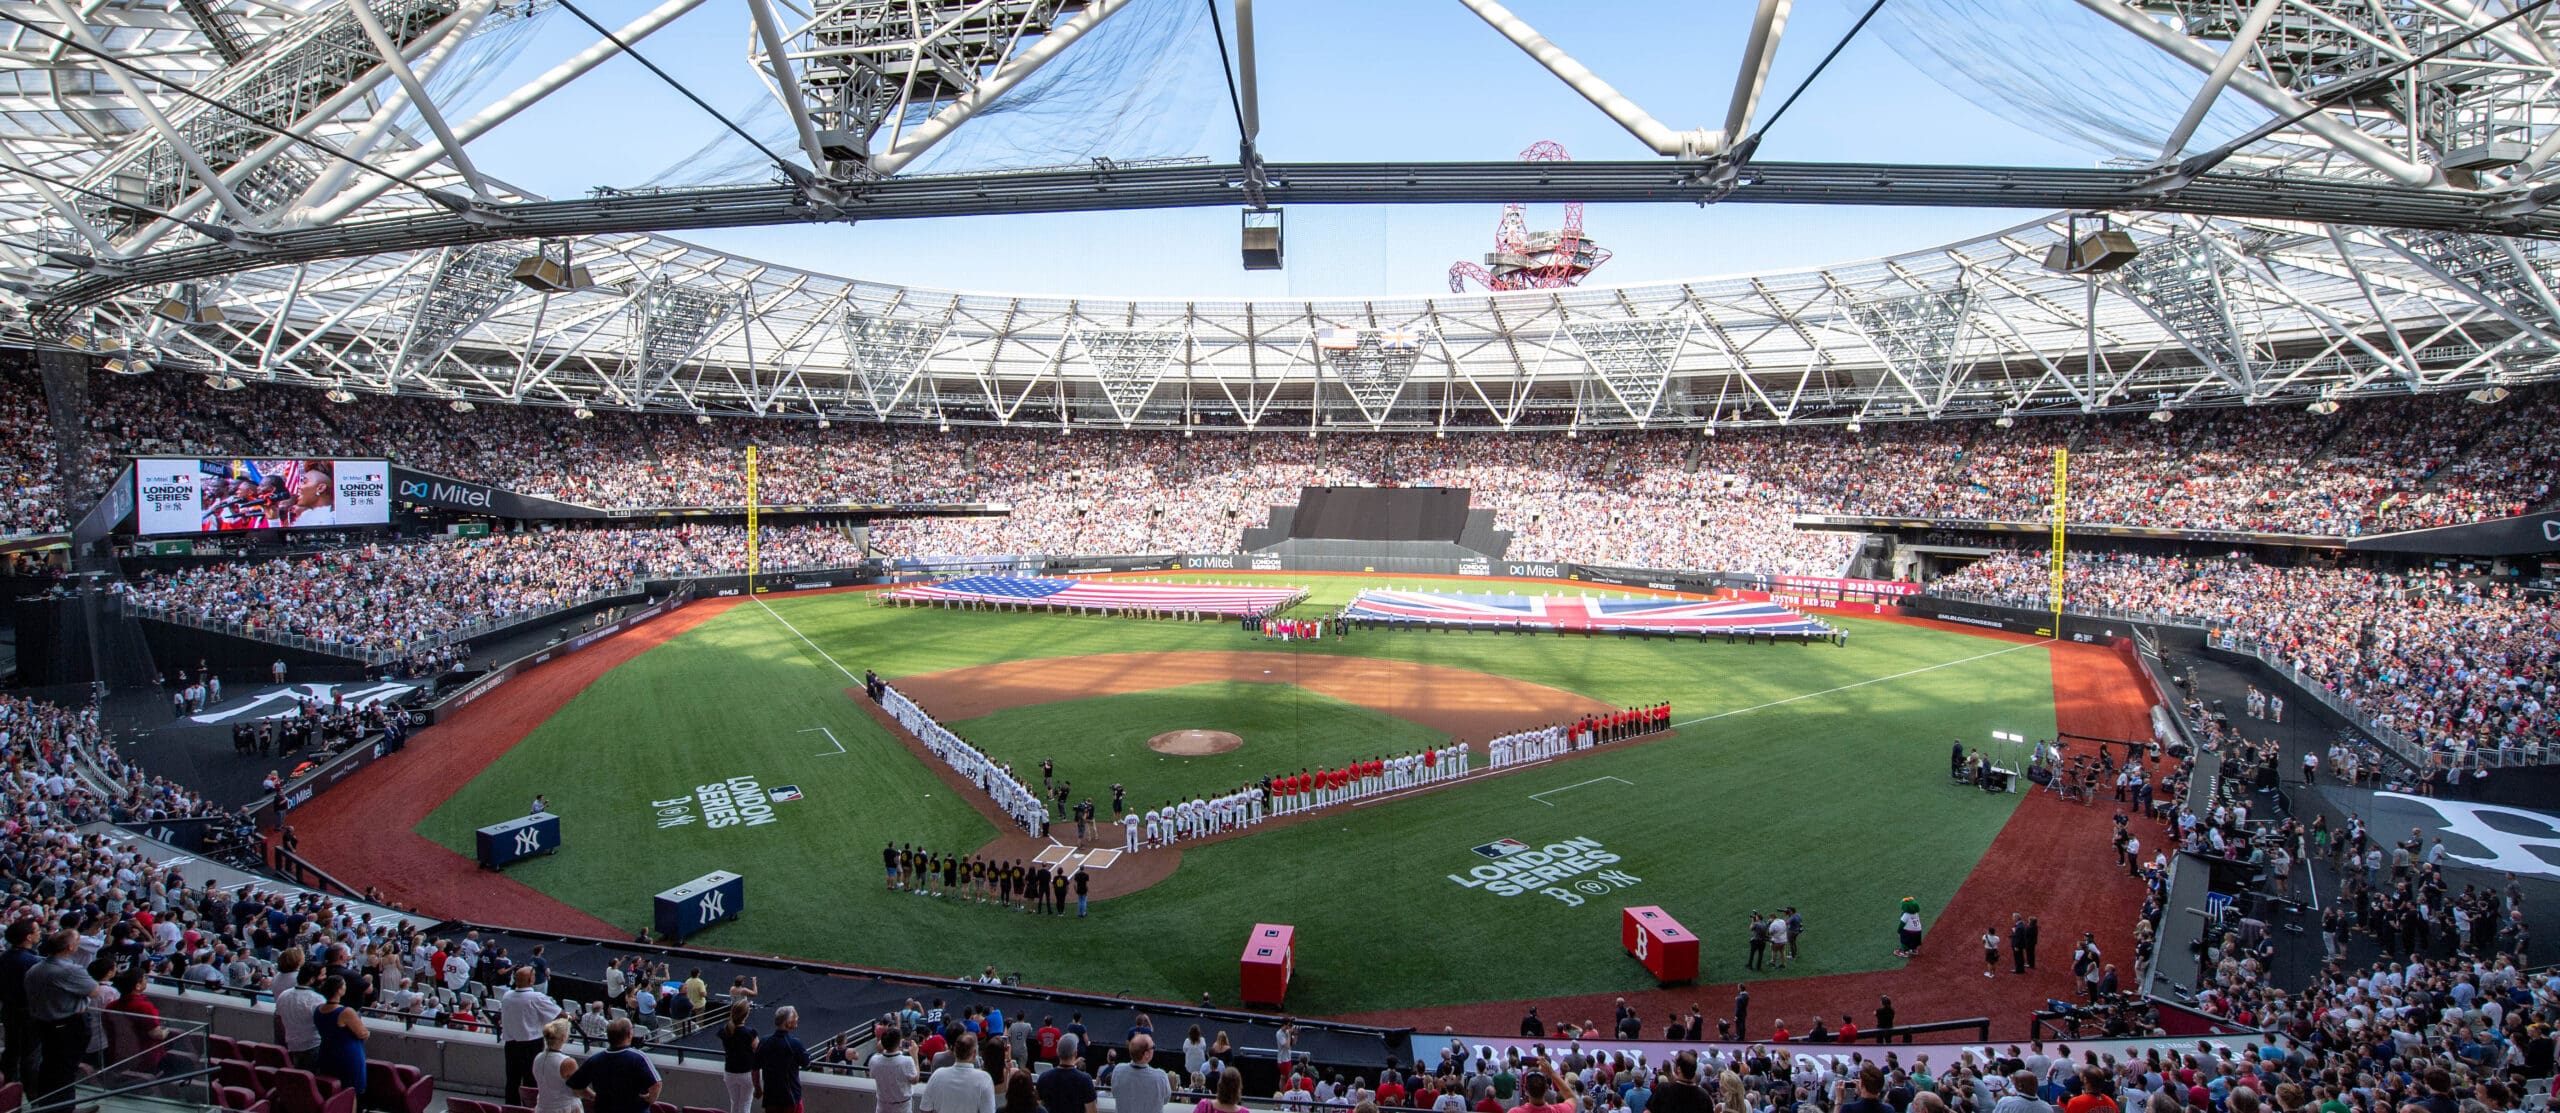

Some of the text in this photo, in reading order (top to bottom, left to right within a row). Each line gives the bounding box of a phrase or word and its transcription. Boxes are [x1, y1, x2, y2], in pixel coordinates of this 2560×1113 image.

[143, 486, 193, 494] LONDON
[146, 494, 190, 502] SERIES
[432, 482, 491, 508] Mitel
[1204, 556, 1233, 568] Mitel
[1527, 564, 1558, 577] Mitel
[1786, 578, 1907, 595] BOSTON RED SOX
[1770, 594, 1837, 608] BOSTON RED SOX
[1874, 604, 1880, 613] B
[469, 675, 502, 701] LONDON SERIES
[295, 785, 313, 804] Mitel
[726, 775, 777, 827] LONDON
[695, 783, 741, 829] SERIES
[514, 826, 540, 856] NY
[1447, 836, 1604, 888] LONDON
[1485, 850, 1621, 897] SERIES
[1540, 887, 1585, 907] B
[700, 890, 724, 924] NY
[1636, 924, 1648, 961] B
[928, 1012, 942, 1022] 22
[1016, 1031, 1023, 1041] 2
